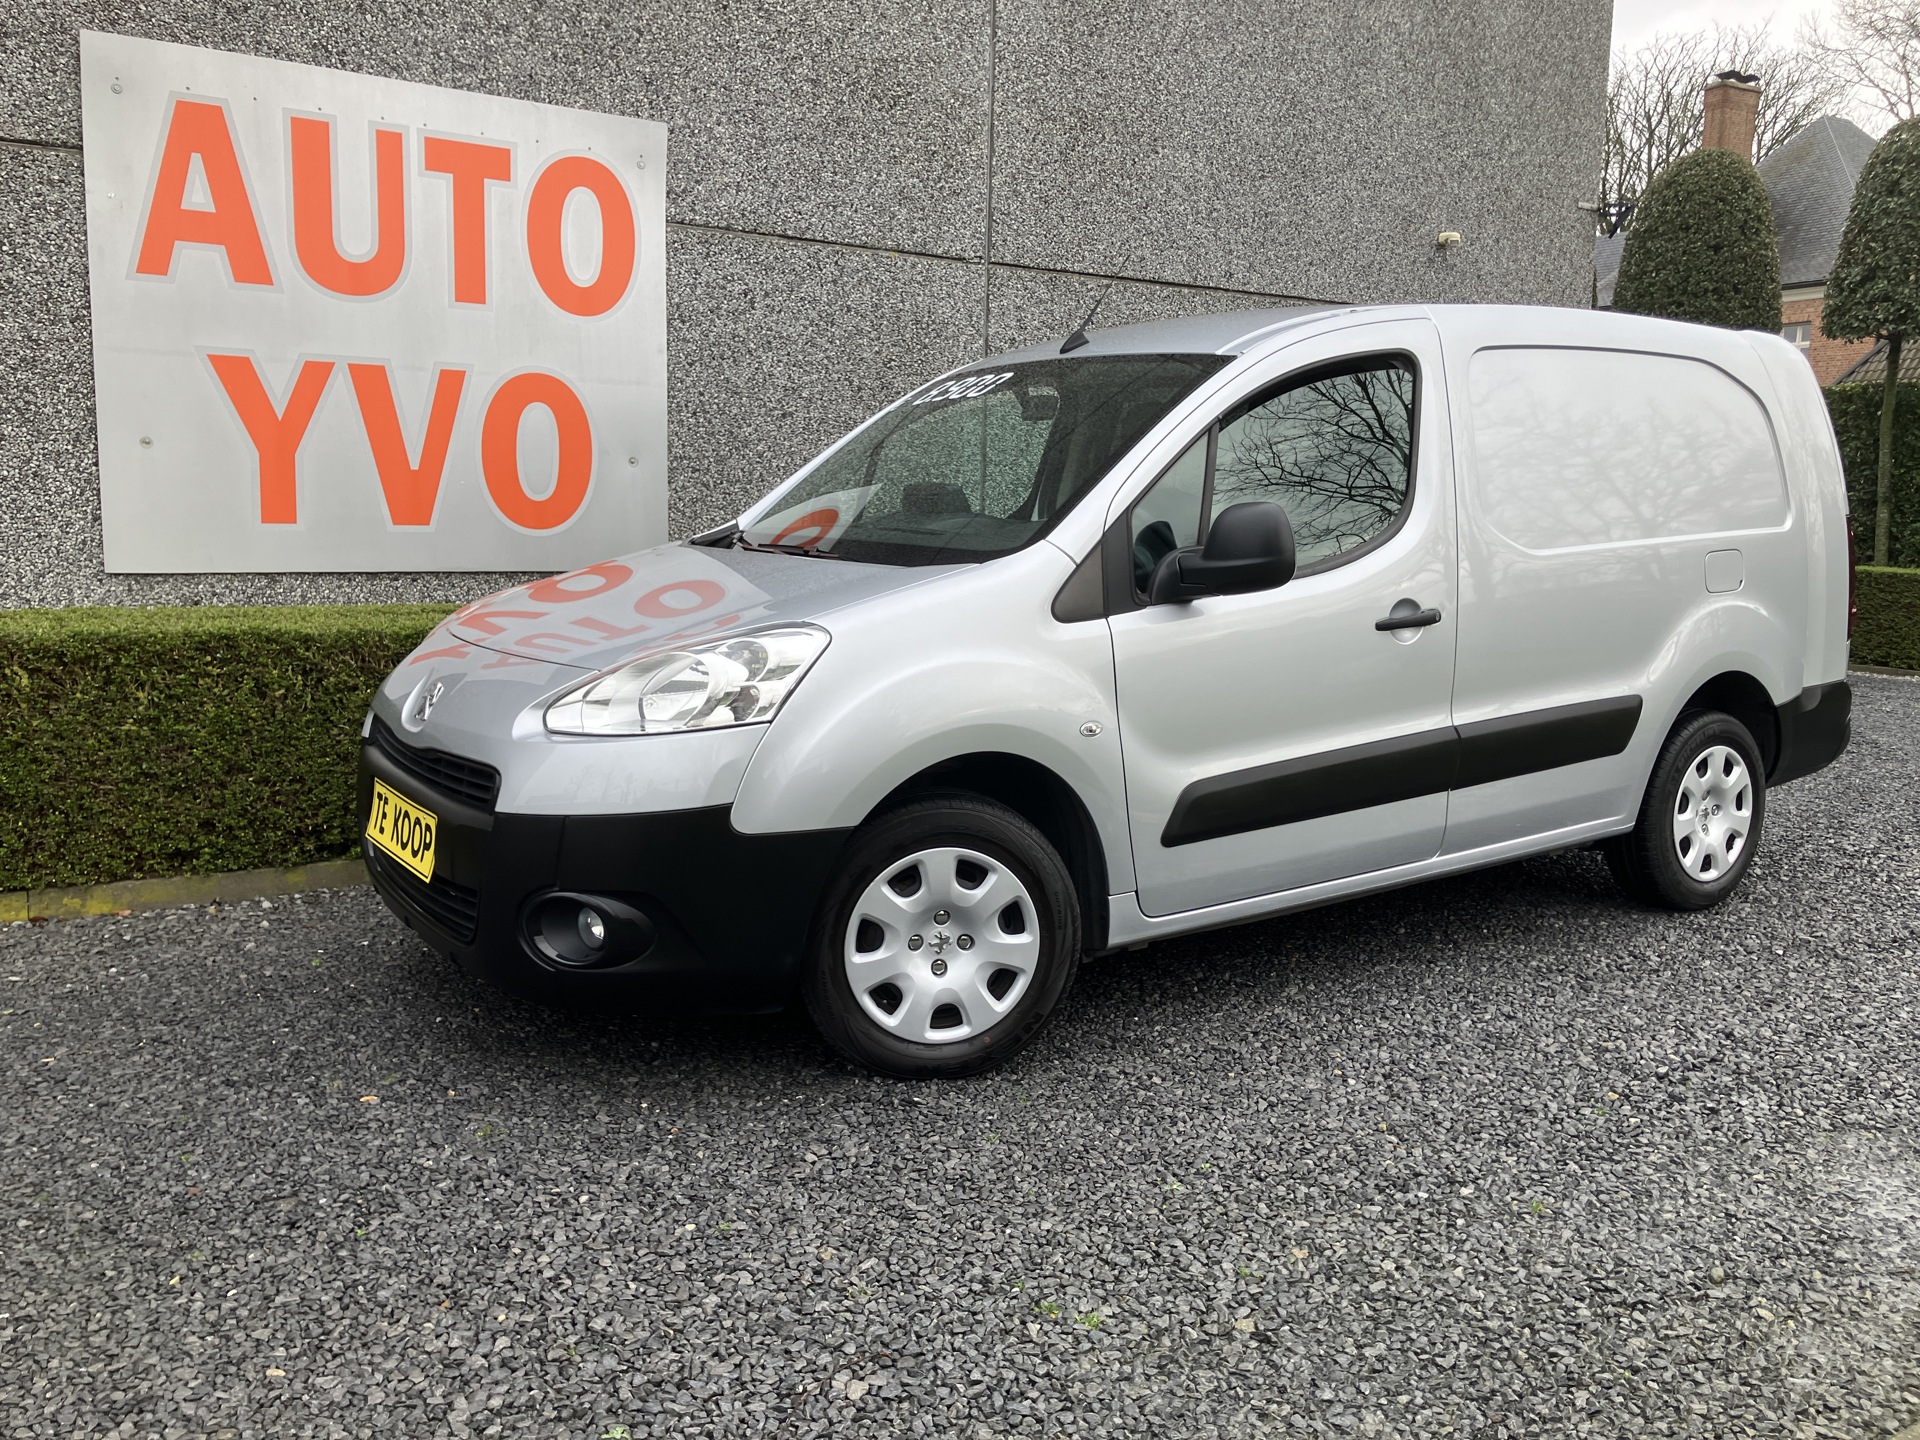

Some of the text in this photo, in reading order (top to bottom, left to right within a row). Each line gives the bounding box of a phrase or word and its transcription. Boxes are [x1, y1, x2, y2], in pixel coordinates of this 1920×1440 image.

[135, 99, 636, 317] AUTO
[206, 353, 593, 530] YVO
[373, 791, 433, 863] TE KOOP
